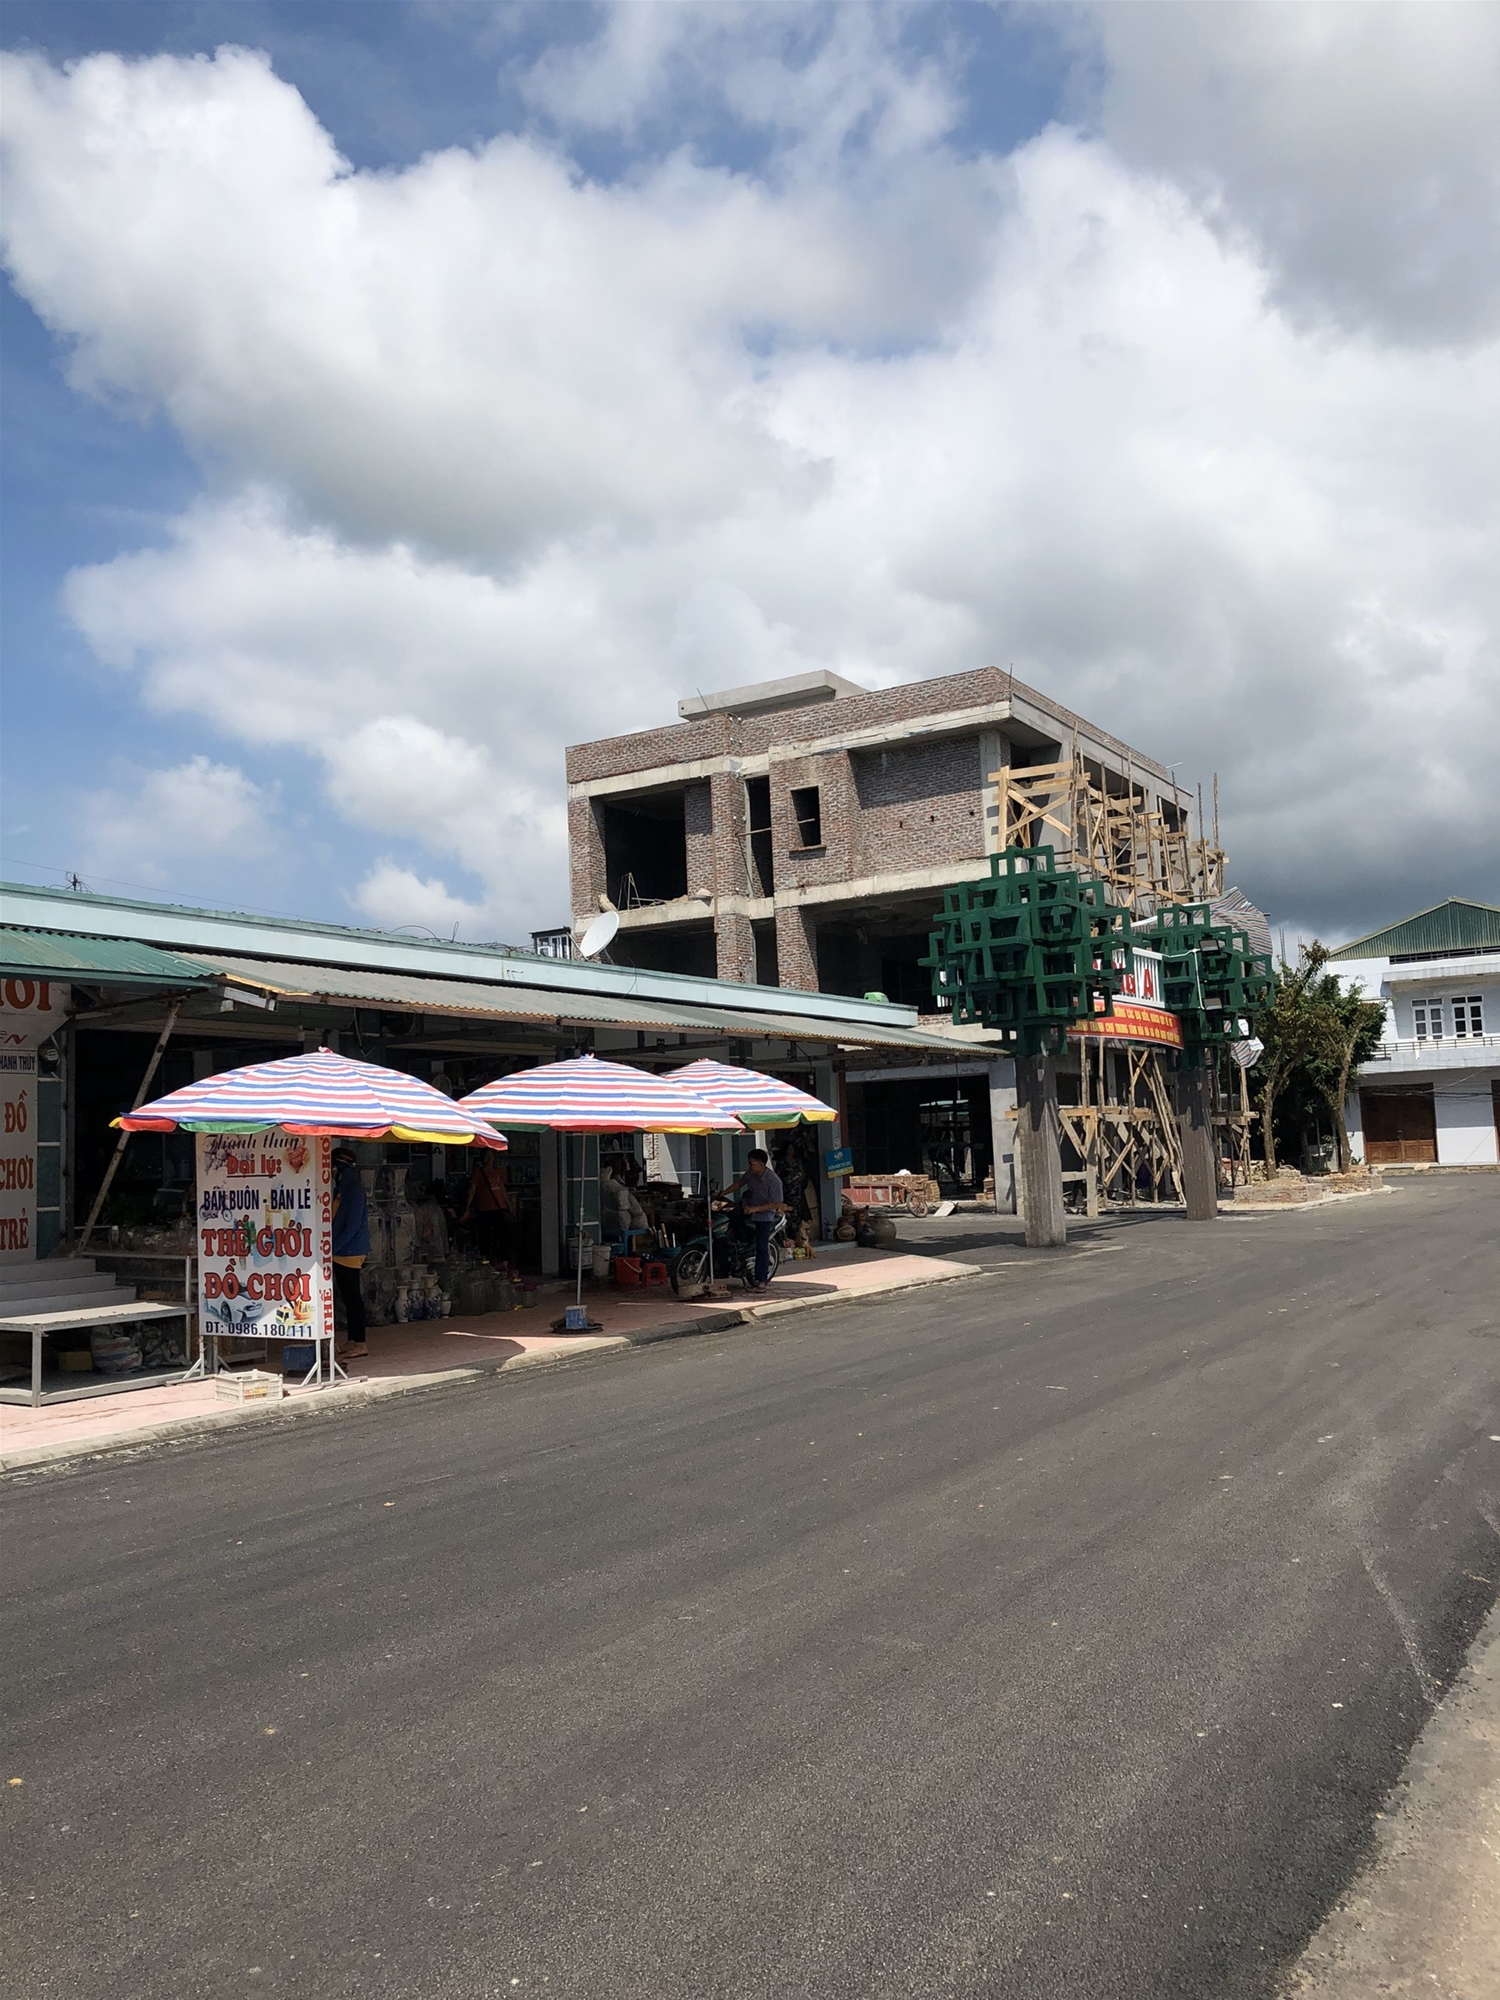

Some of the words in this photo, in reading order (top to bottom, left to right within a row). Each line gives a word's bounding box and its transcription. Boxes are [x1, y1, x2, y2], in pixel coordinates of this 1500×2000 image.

[4, 1089, 28, 1134] ĐỒ
[226, 1154, 255, 1178] Đại
[203, 1185, 226, 1210] BÁN
[229, 1185, 259, 1210] BUÔN
[270, 1184, 294, 1210] BÁN
[297, 1178, 311, 1210] LẺ
[316, 1191, 331, 1223] ĐỒ
[201, 1214, 251, 1257] THẾ
[256, 1219, 312, 1257] GIỚI
[319, 1230, 332, 1281] GIỚI
[204, 1258, 240, 1300] ĐỒ
[246, 1267, 311, 1302] CHƠI
[205, 1321, 225, 1334] ĐT:
[227, 1322, 312, 1338] 0986.180.111
[318, 1287, 333, 1335] THẾ
